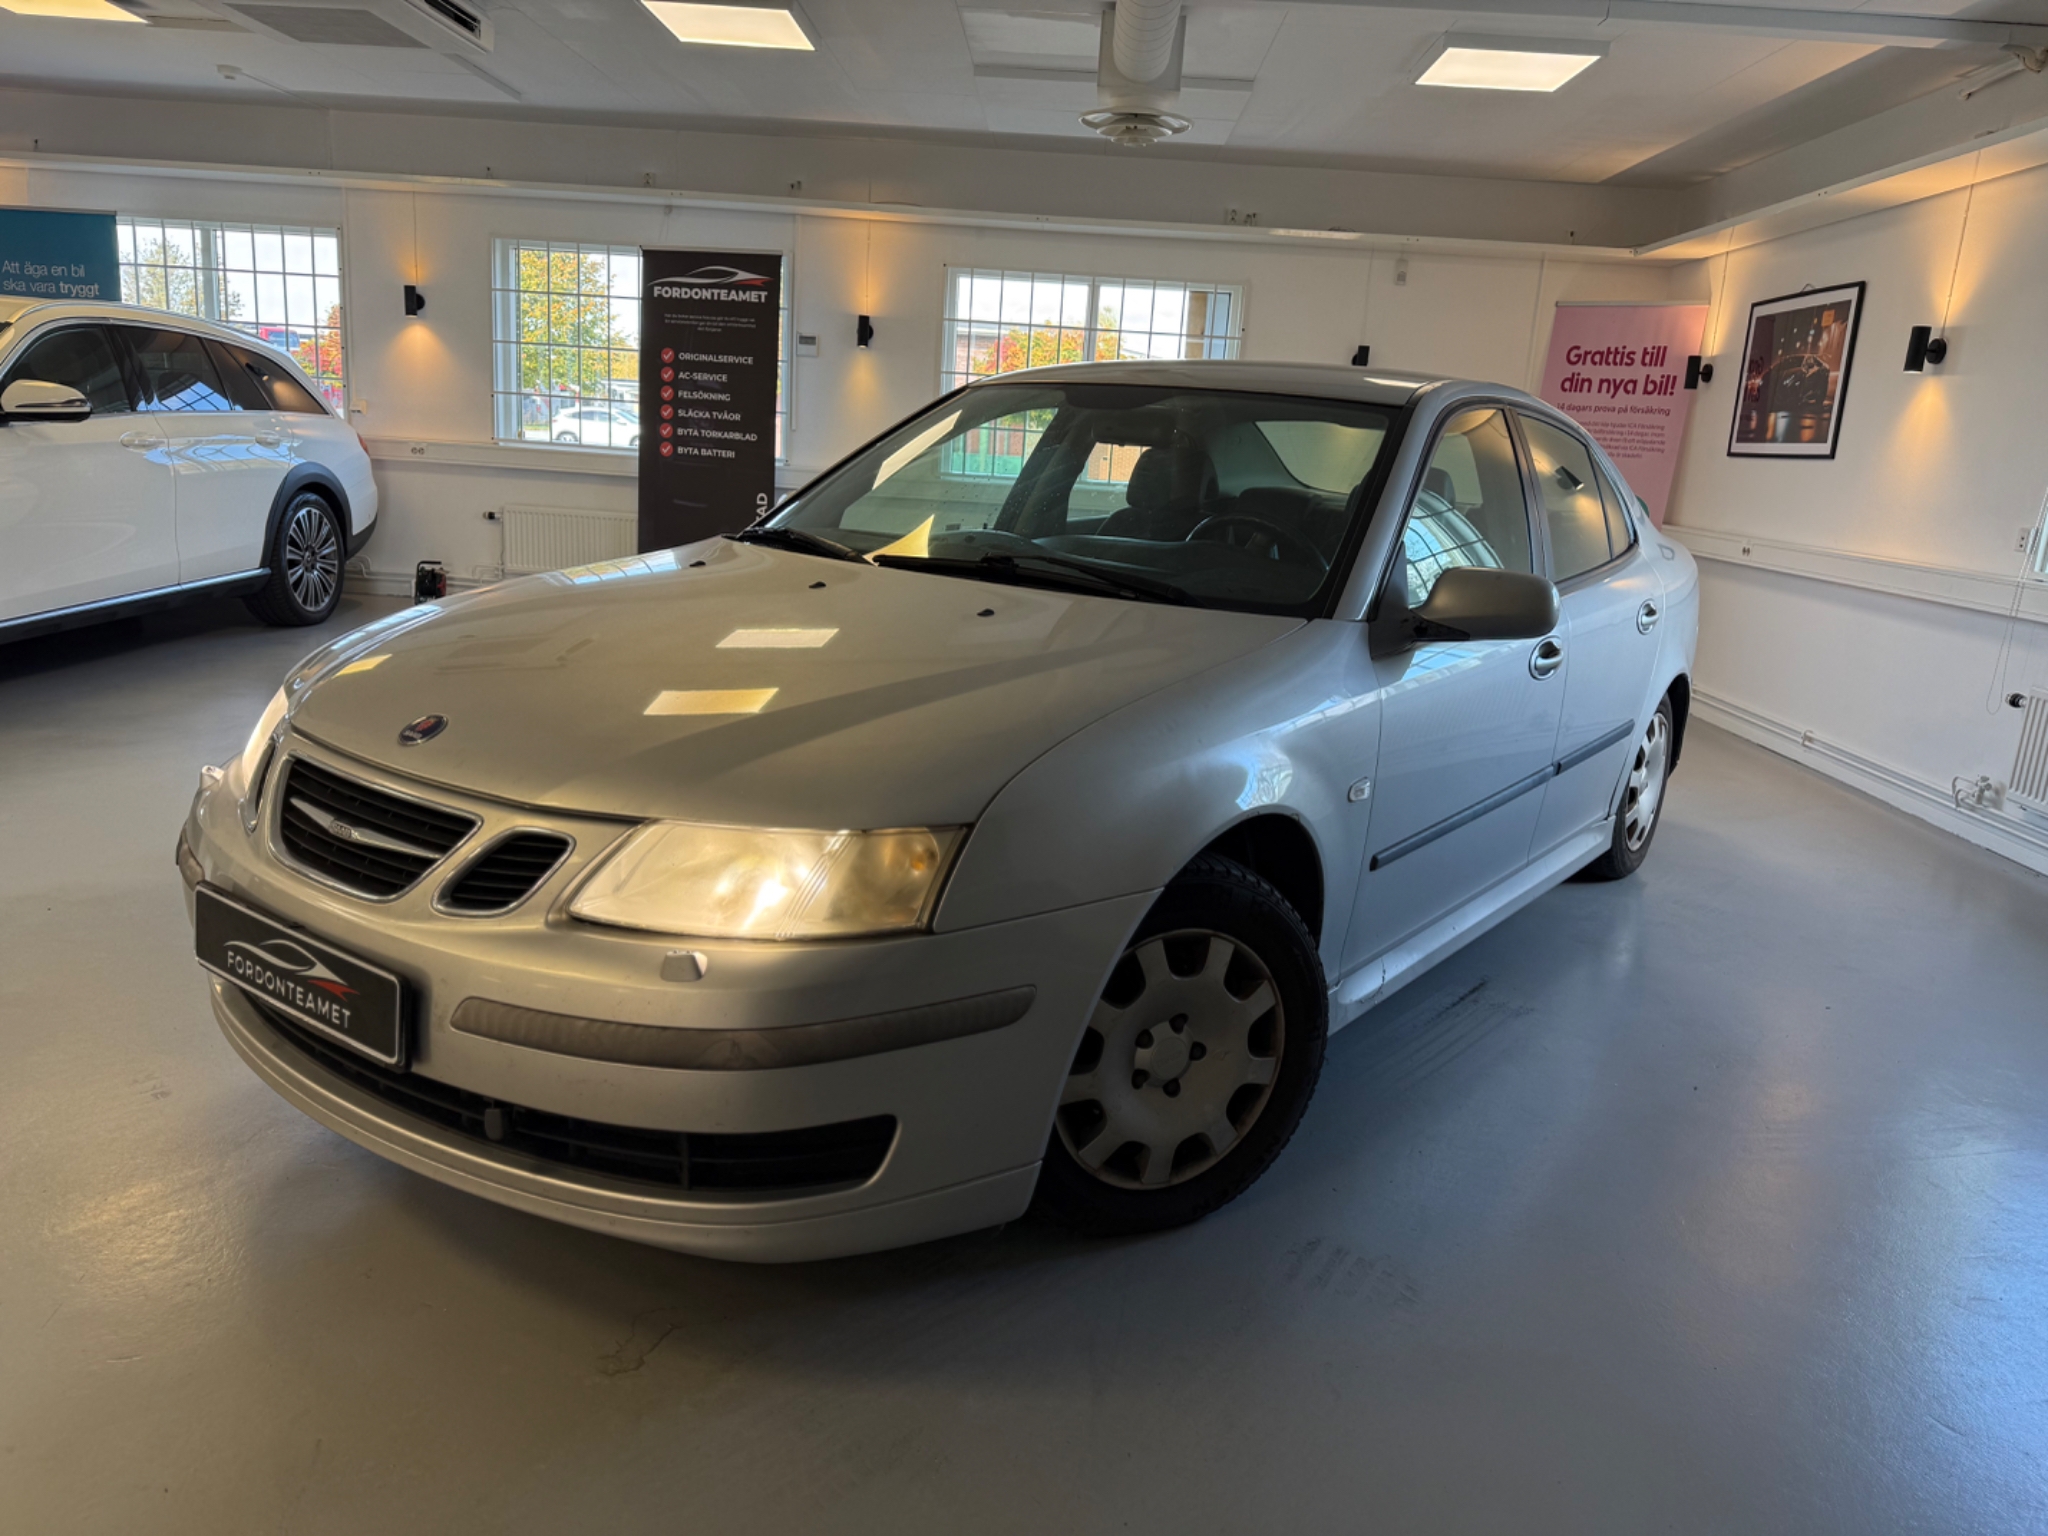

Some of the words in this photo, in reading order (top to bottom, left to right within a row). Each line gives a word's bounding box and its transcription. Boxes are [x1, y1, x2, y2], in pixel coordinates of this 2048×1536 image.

[2, 260, 20, 275] Att
[24, 261, 48, 278] äga
[51, 265, 67, 277] en
[71, 264, 86, 278] bil
[3, 278, 26, 292] ska
[30, 282, 56, 294] vara
[59, 281, 100, 298] tryggt
[653, 286, 768, 303] FORDONTEAMET
[678, 352, 754, 365] ORIGINALSERVICE
[1566, 345, 1637, 367] Grattis
[1640, 345, 1669, 367] till
[678, 371, 728, 383] AC-SERVICE
[1560, 372, 1593, 394] din
[1597, 377, 1639, 399] nya
[1642, 374, 1678, 397] bil!
[678, 389, 731, 402] FELSÖKNING
[712, 410, 742, 422] TVÅOR
[1566, 403, 1593, 413] dagars
[1593, 405, 1616, 414] prova
[1617, 404, 1629, 415] på
[1629, 405, 1672, 417] försäkring
[677, 427, 699, 438] BYTA
[700, 429, 758, 442] TORKARBLAD
[677, 446, 699, 456] BYTA
[701, 448, 736, 459] BATTERI
[227, 950, 352, 1029] FORDONTEAMET
